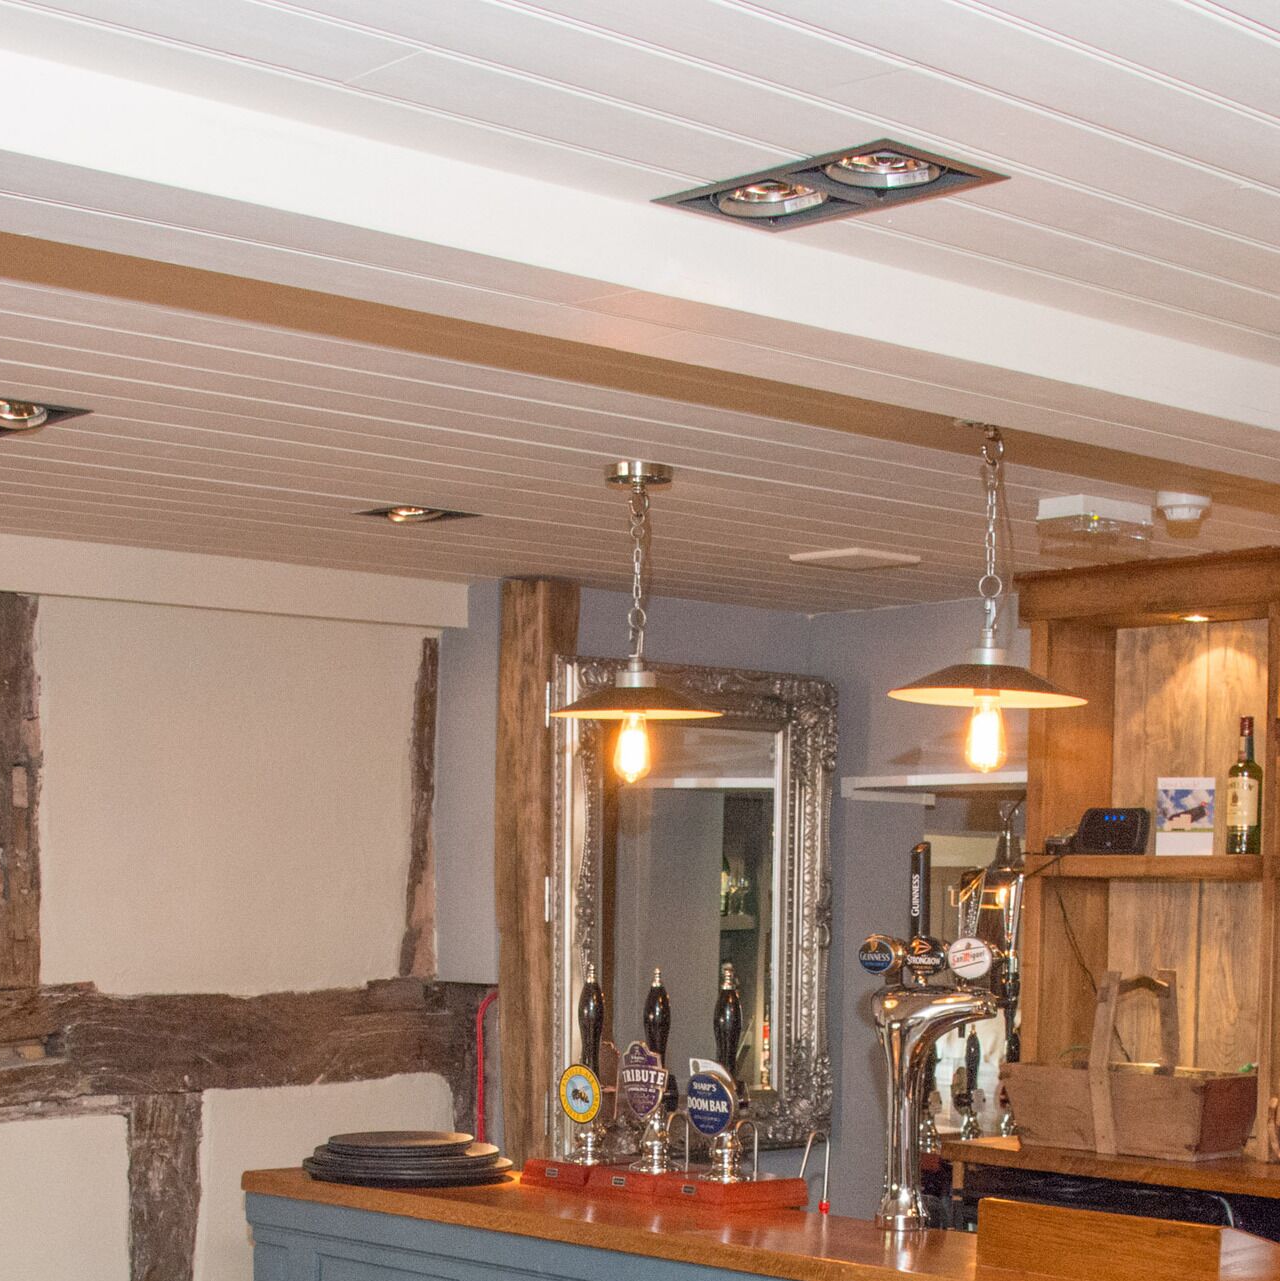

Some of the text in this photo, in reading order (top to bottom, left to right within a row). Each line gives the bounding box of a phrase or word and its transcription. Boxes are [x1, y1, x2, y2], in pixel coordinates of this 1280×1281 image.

[911, 873, 920, 917] GUINNESS
[859, 951, 891, 962] GUINNESS
[906, 954, 941, 966] STRONGBOW
[622, 1069, 665, 1086] TRIBUTE
[692, 1081, 717, 1092] SHARP'S
[687, 1095, 729, 1113] DOOM BAR
